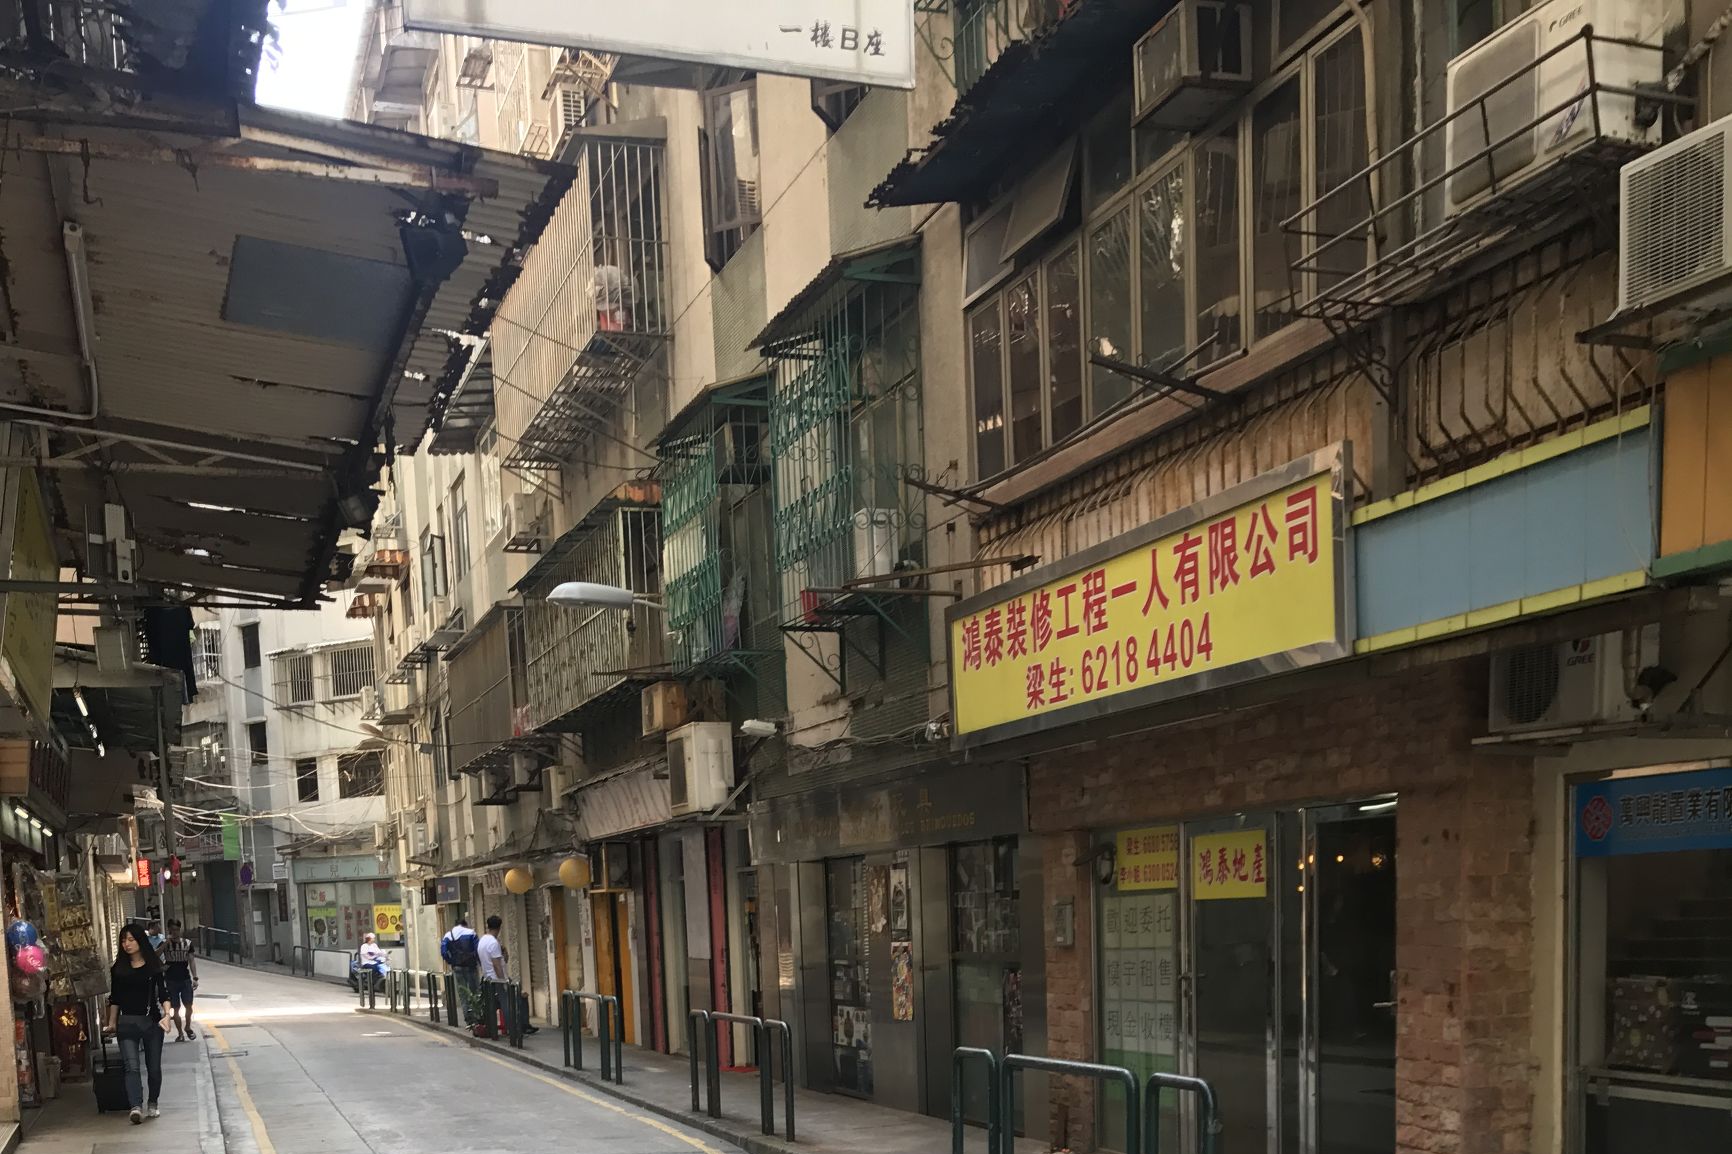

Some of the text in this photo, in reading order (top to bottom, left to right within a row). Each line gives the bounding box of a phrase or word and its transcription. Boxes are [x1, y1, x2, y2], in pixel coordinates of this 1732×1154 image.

[962, 485, 1319, 672] 鴻泰裝修工程一人有限公司
[1081, 635, 1138, 695] 6218
[1146, 611, 1213, 677] 4404
